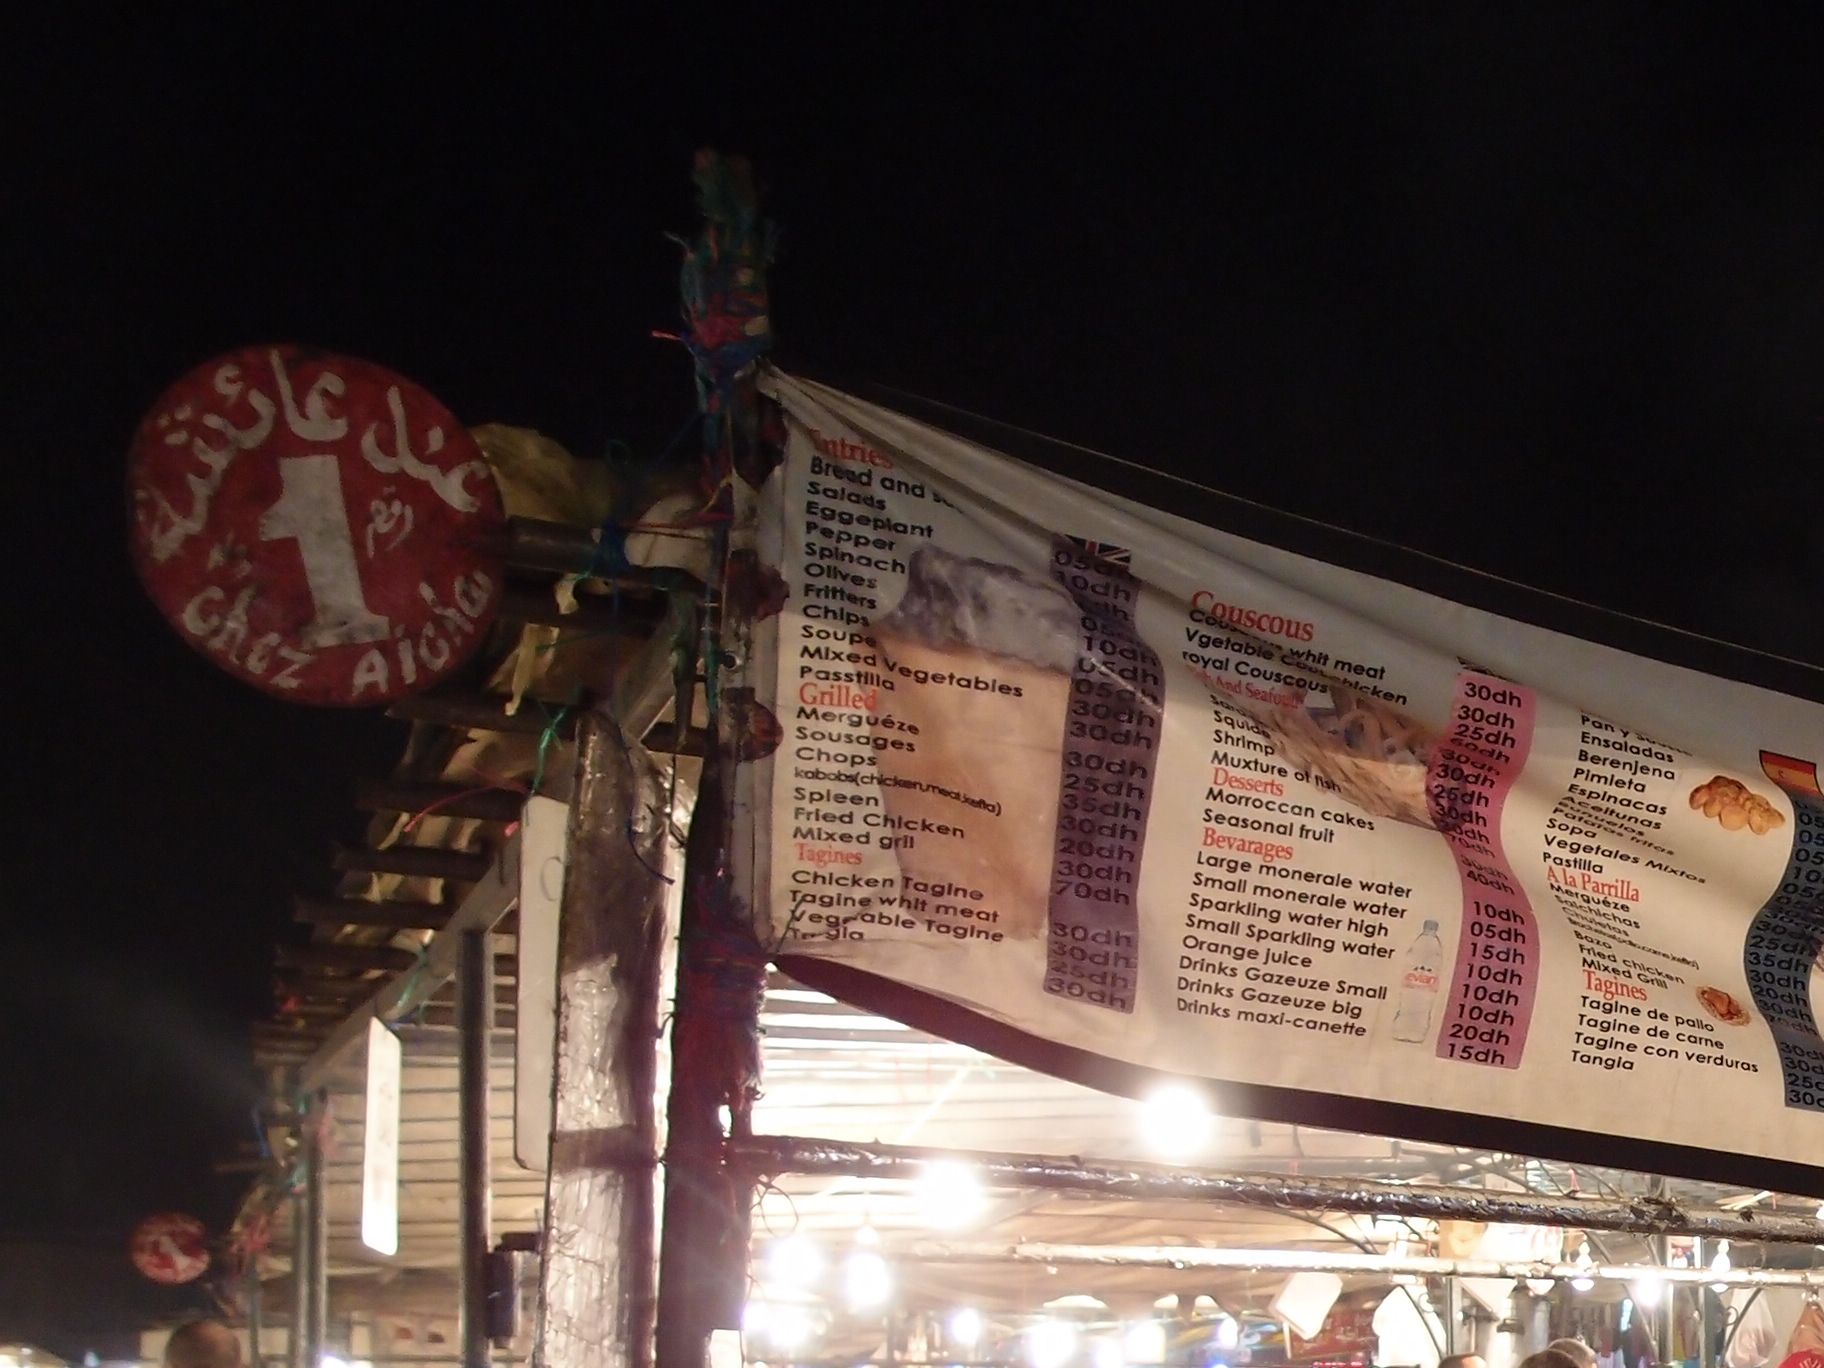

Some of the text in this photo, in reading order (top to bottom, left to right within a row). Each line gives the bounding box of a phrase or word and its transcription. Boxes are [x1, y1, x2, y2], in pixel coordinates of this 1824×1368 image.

[811, 456, 925, 499] Bread and
[806, 481, 887, 511] Salads
[805, 501, 934, 538] Eggeplant
[258, 454, 390, 650] 1
[806, 522, 896, 552] Pepper
[805, 542, 906, 574] Spinach
[804, 562, 878, 589] Olives
[804, 584, 877, 609] Fritters
[802, 604, 870, 628] Chips
[1191, 590, 1315, 643] Couscous
[1185, 627, 1276, 663] Vgetable
[799, 666, 896, 692] Passtilla
[1182, 650, 1229, 671] royal
[1235, 662, 1330, 694] Couscous
[1289, 648, 1386, 681] whit meat
[799, 682, 878, 711] Grilled
[1464, 681, 1523, 709] 30dh
[796, 706, 920, 735] Merguéze
[1580, 715, 1630, 739] Pan y
[795, 726, 916, 752] Sousages
[1213, 730, 1276, 757] Shrimp
[1454, 724, 1517, 750] 25dh
[1580, 731, 1675, 764] Ensaladas
[795, 747, 878, 768] Chops
[1065, 751, 1148, 780] 30dh
[1578, 749, 1676, 781] Berenjena
[794, 787, 879, 808] Spleen
[1213, 767, 1285, 797] Desserts
[1205, 787, 1376, 832] Morroccan cakes
[1567, 782, 1668, 816] Espinacas
[794, 807, 965, 839] Fried Chicken
[1061, 816, 1138, 842] 30dh
[1202, 808, 1335, 844] Seasonal fruit
[1546, 817, 1598, 841] Sopa
[796, 843, 863, 870] Tagines
[1202, 827, 1294, 863] Bevarages
[1196, 851, 1413, 899] Large monerale water
[1543, 852, 1604, 875] Pastilla
[791, 869, 984, 901] Chicken Tagine
[1055, 881, 1130, 906] 70dh
[1192, 871, 1408, 919] Small monerale water
[1546, 865, 1641, 903] A la Parrilla
[1549, 883, 1632, 914] Merguéze
[789, 890, 1000, 924] Tagine whit meat
[1188, 893, 1390, 941] Sparkling water high
[1472, 901, 1526, 925] 10dh
[1185, 913, 1396, 960] Small Sparkling water
[1182, 935, 1314, 970] Orange juice
[1469, 942, 1527, 965] 15dh
[1579, 944, 1618, 964] Fried
[1748, 951, 1809, 975] 35dh
[1179, 955, 1389, 1001] Drinks Gazeuze Small
[1582, 958, 1669, 990] Mixed Grill
[1582, 969, 1648, 1002] Tagines
[1177, 976, 1363, 1021] Drinks Gazeuze big
[1462, 983, 1519, 1007] 10dh
[1177, 998, 1367, 1038] Drinks maxi-canette
[1578, 1014, 1725, 1051] Tagine de carne
[1447, 1043, 1506, 1067] 15dh
[1571, 1051, 1634, 1075] Tangia
[1574, 1032, 1759, 1073] Tagine con verduras
